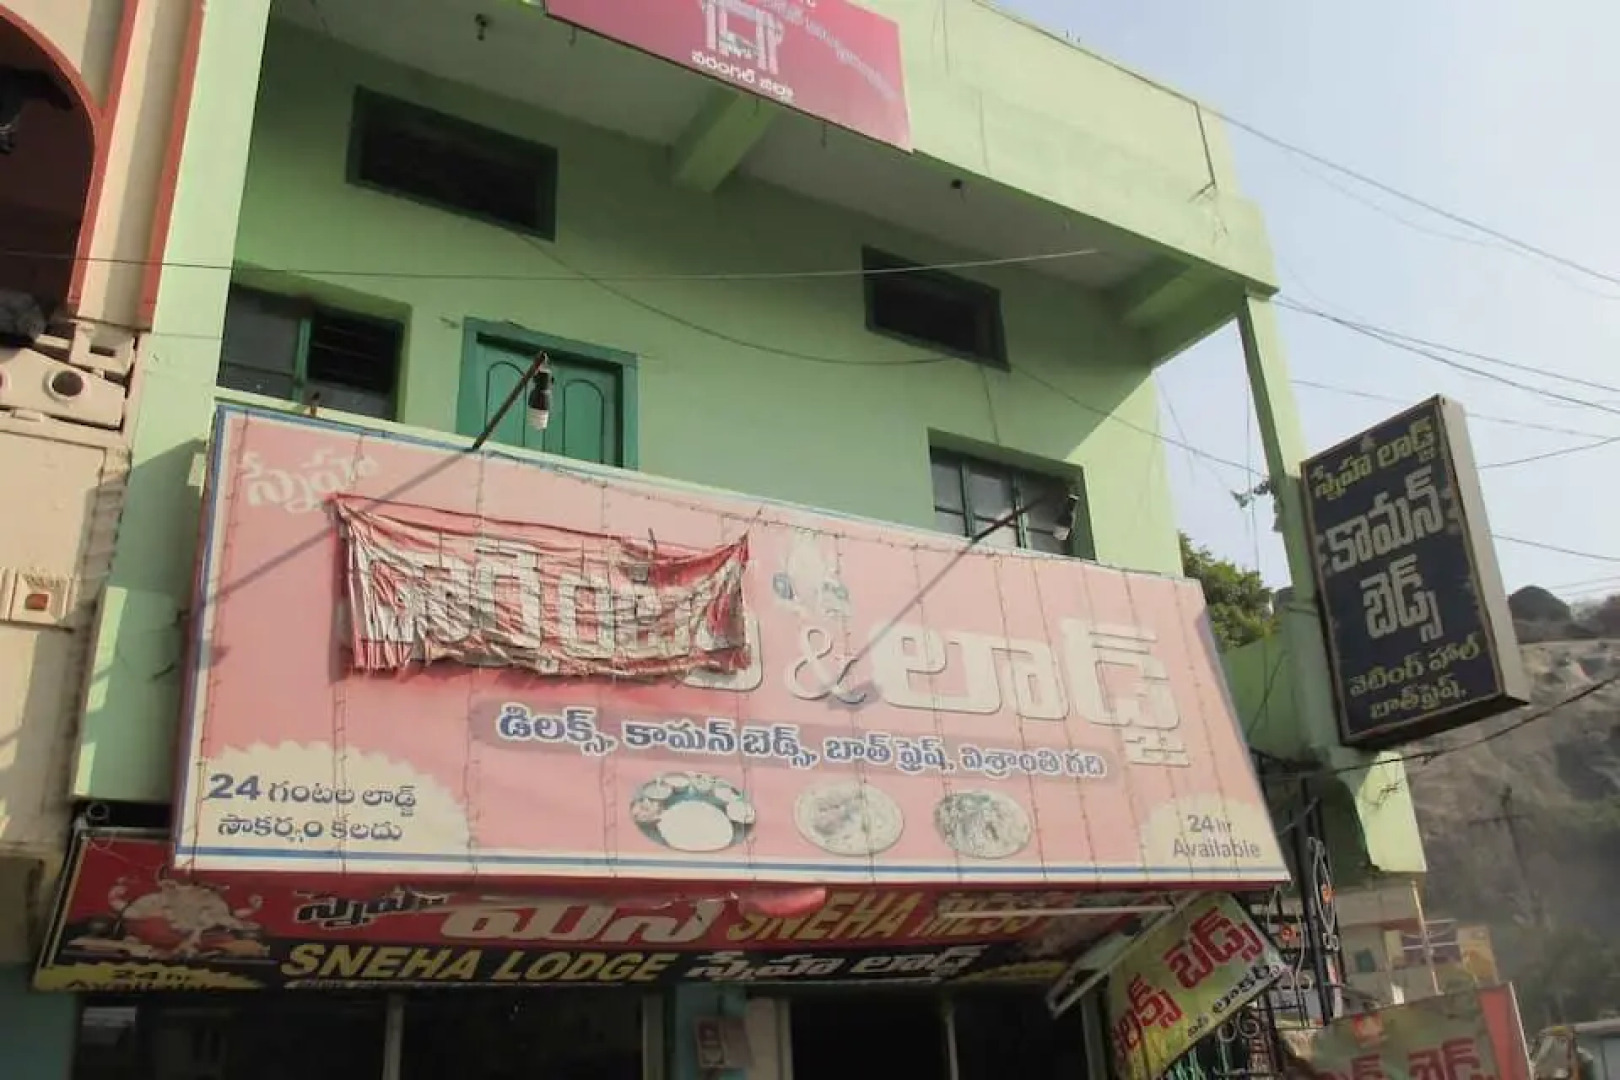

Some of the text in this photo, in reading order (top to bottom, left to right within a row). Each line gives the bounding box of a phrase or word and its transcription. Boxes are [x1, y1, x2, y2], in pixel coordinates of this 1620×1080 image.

[785, 628, 868, 703] &
[623, 718, 737, 753] కామన్
[210, 773, 261, 800] 24
[268, 780, 355, 803] గంటల
[1173, 838, 1261, 858] Available
[281, 944, 679, 982] SNEHA LODGE
